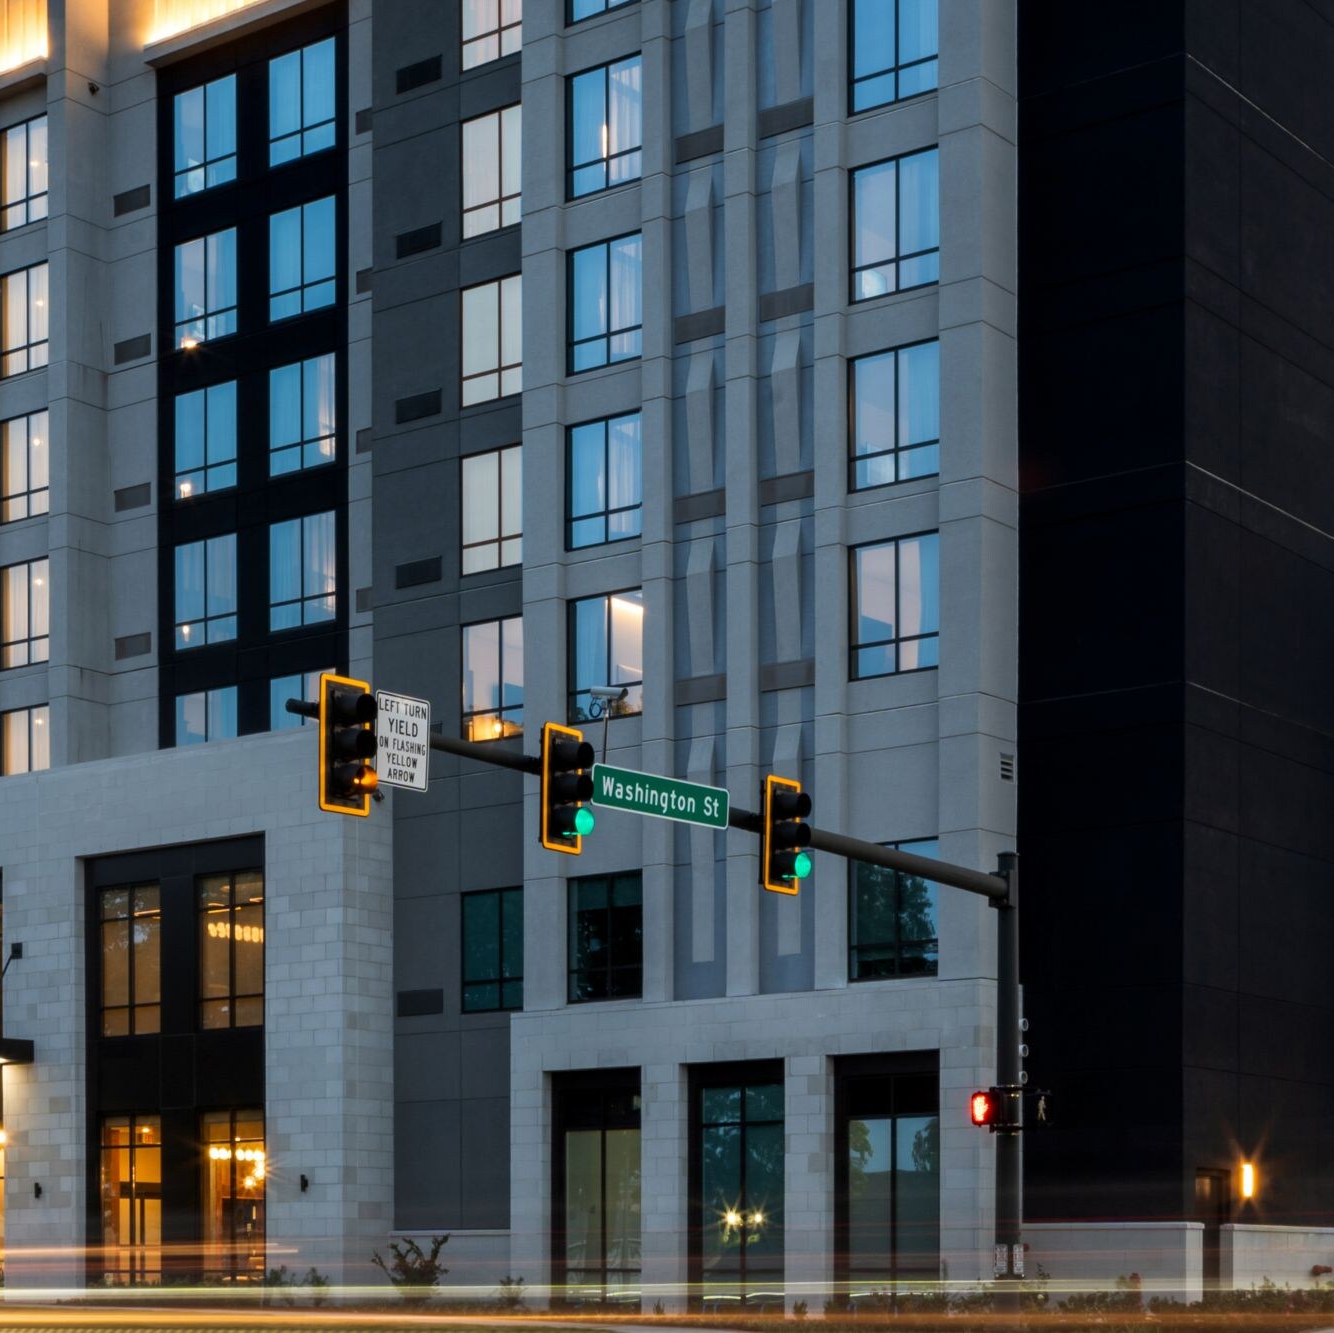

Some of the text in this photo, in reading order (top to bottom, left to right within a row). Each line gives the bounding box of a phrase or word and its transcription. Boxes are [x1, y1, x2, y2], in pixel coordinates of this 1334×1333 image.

[379, 697, 427, 720] LEFT TURN
[388, 717, 419, 738] YIELD
[379, 735, 426, 756] ON FLASHING
[386, 752, 418, 769] YELLOW
[387, 767, 415, 783] ARROW
[602, 775, 720, 818] Washington St
